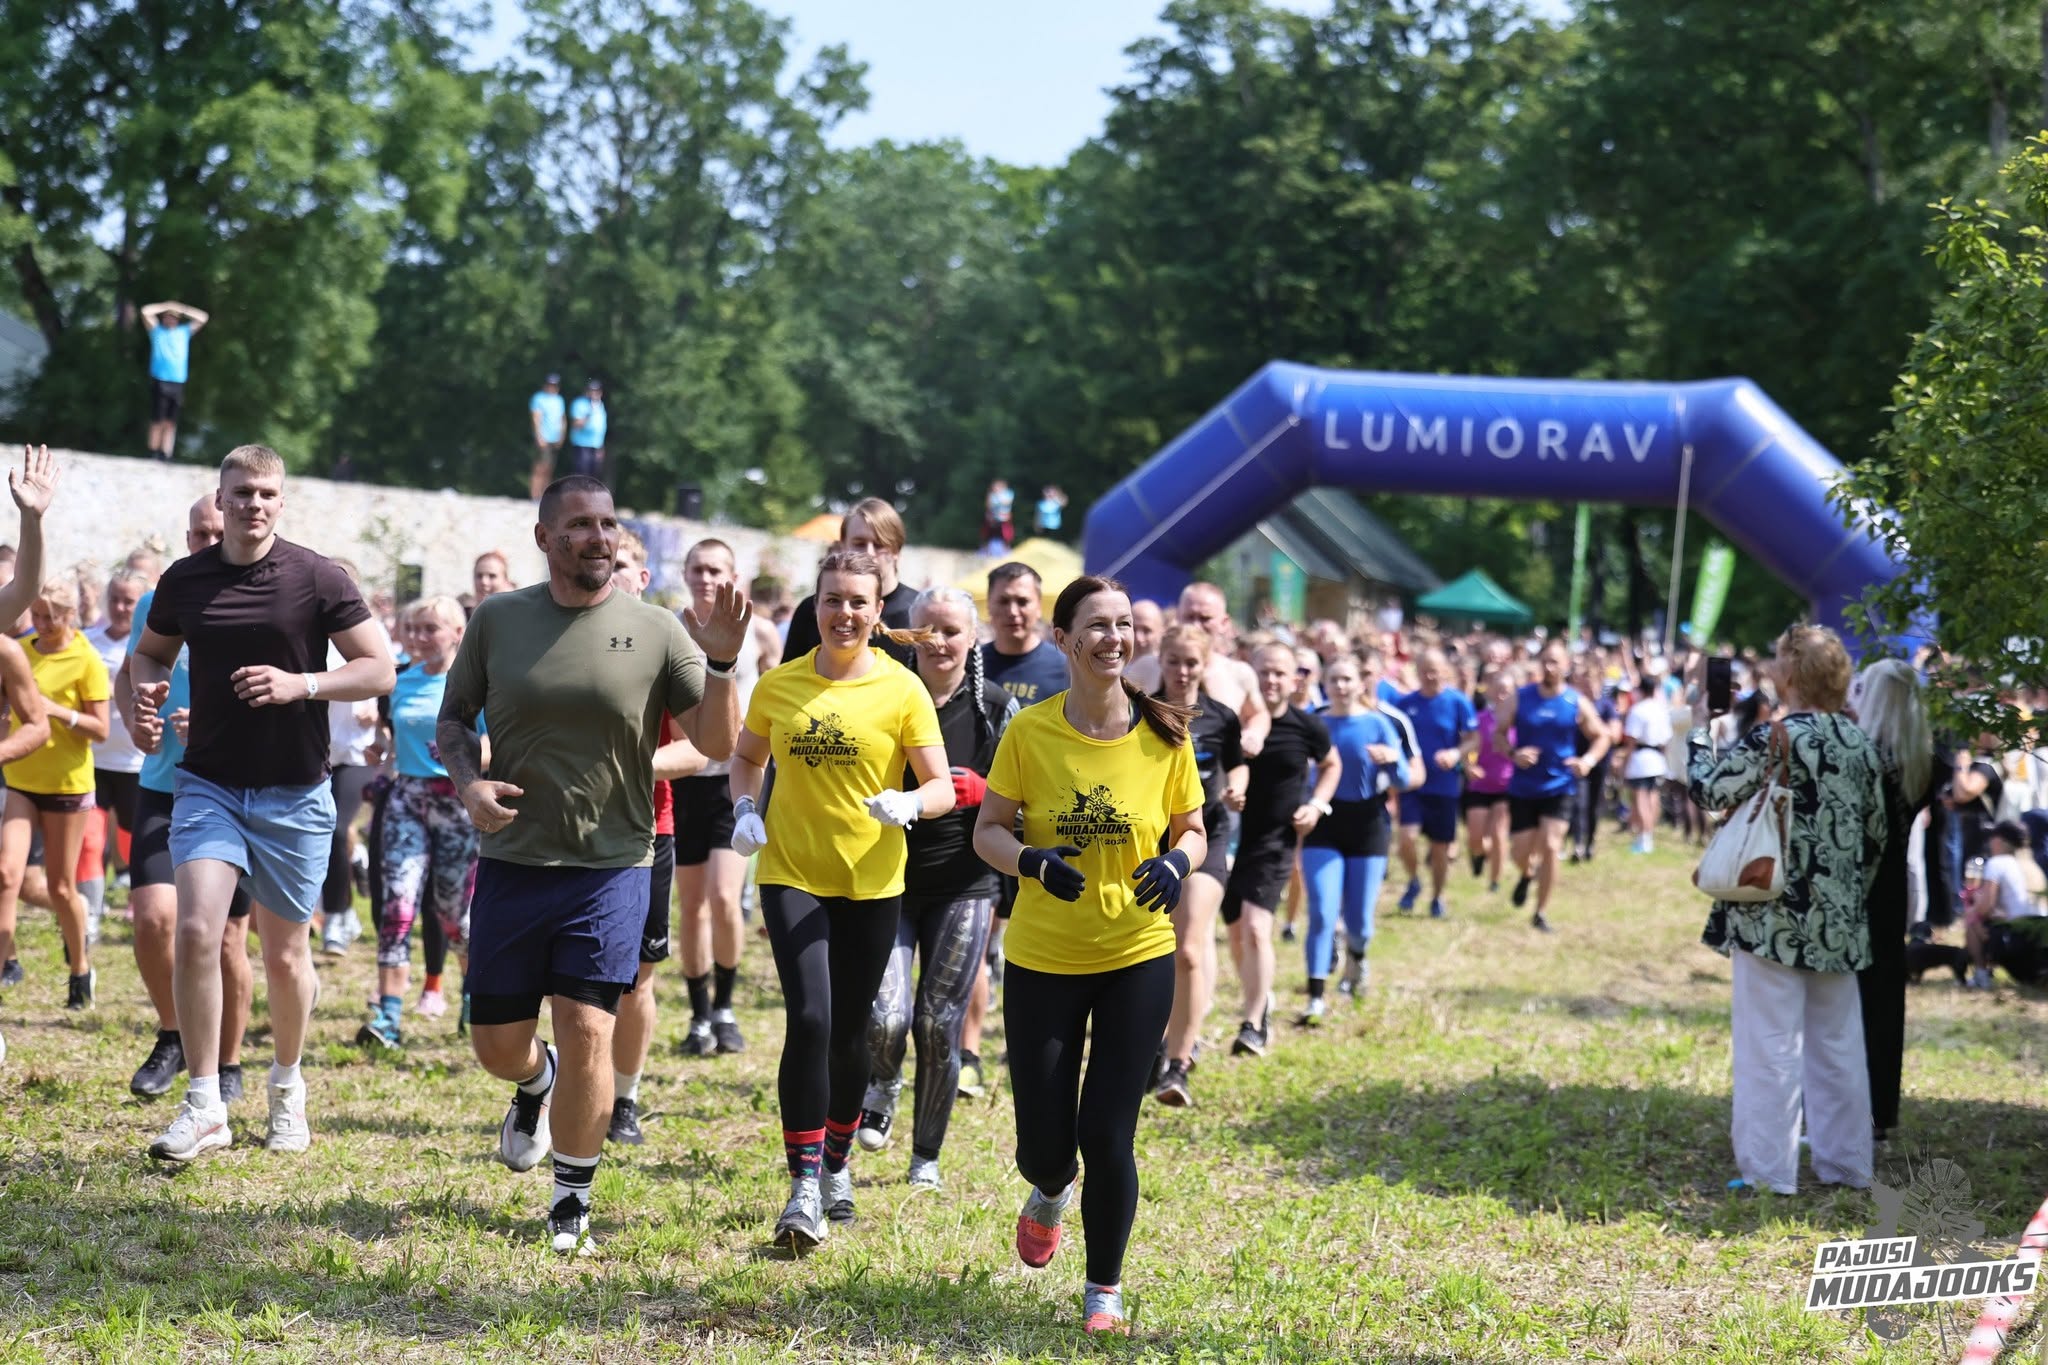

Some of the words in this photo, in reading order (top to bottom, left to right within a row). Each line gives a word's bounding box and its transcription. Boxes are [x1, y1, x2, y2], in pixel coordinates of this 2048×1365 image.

[1324, 409, 1658, 463] LUMIORAV
[792, 735, 820, 744] PAJUSI
[789, 745, 859, 756] MUDAJOOKS
[1057, 813, 1090, 823] PAJUSI
[1056, 823, 1132, 836] MUDAJOOKS
[1104, 838, 1127, 846] 2026
